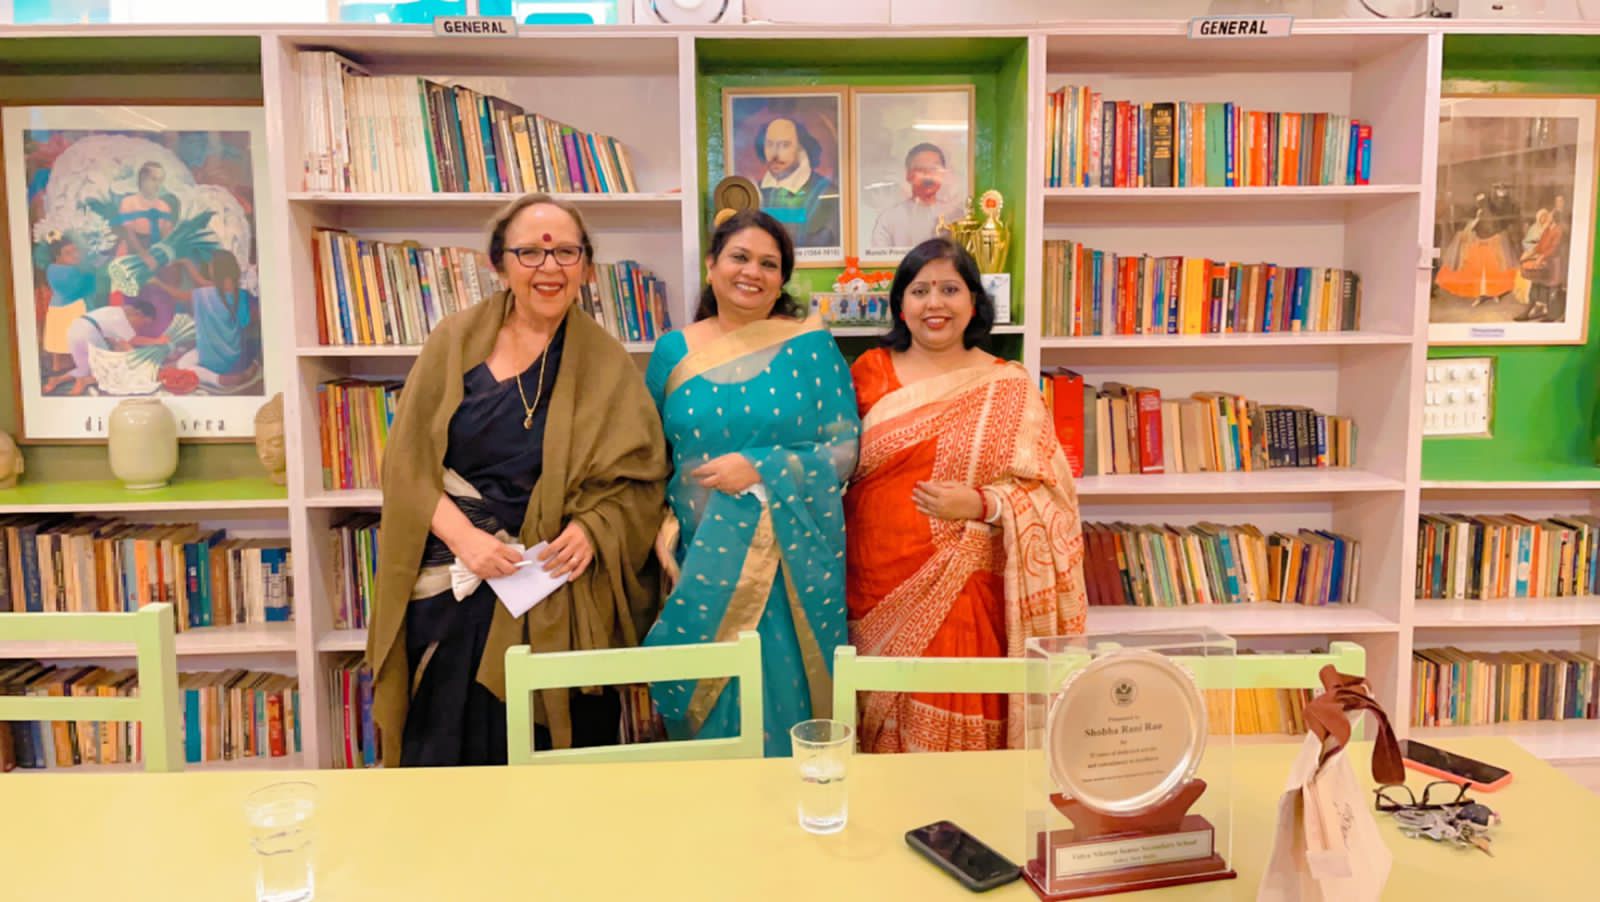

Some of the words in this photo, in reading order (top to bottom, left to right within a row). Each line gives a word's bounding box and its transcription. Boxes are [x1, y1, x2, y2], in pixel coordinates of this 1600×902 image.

[444, 21, 507, 33] GENERAL
[1200, 20, 1268, 35] GENERAL
[1084, 727, 1119, 737] Shobha
